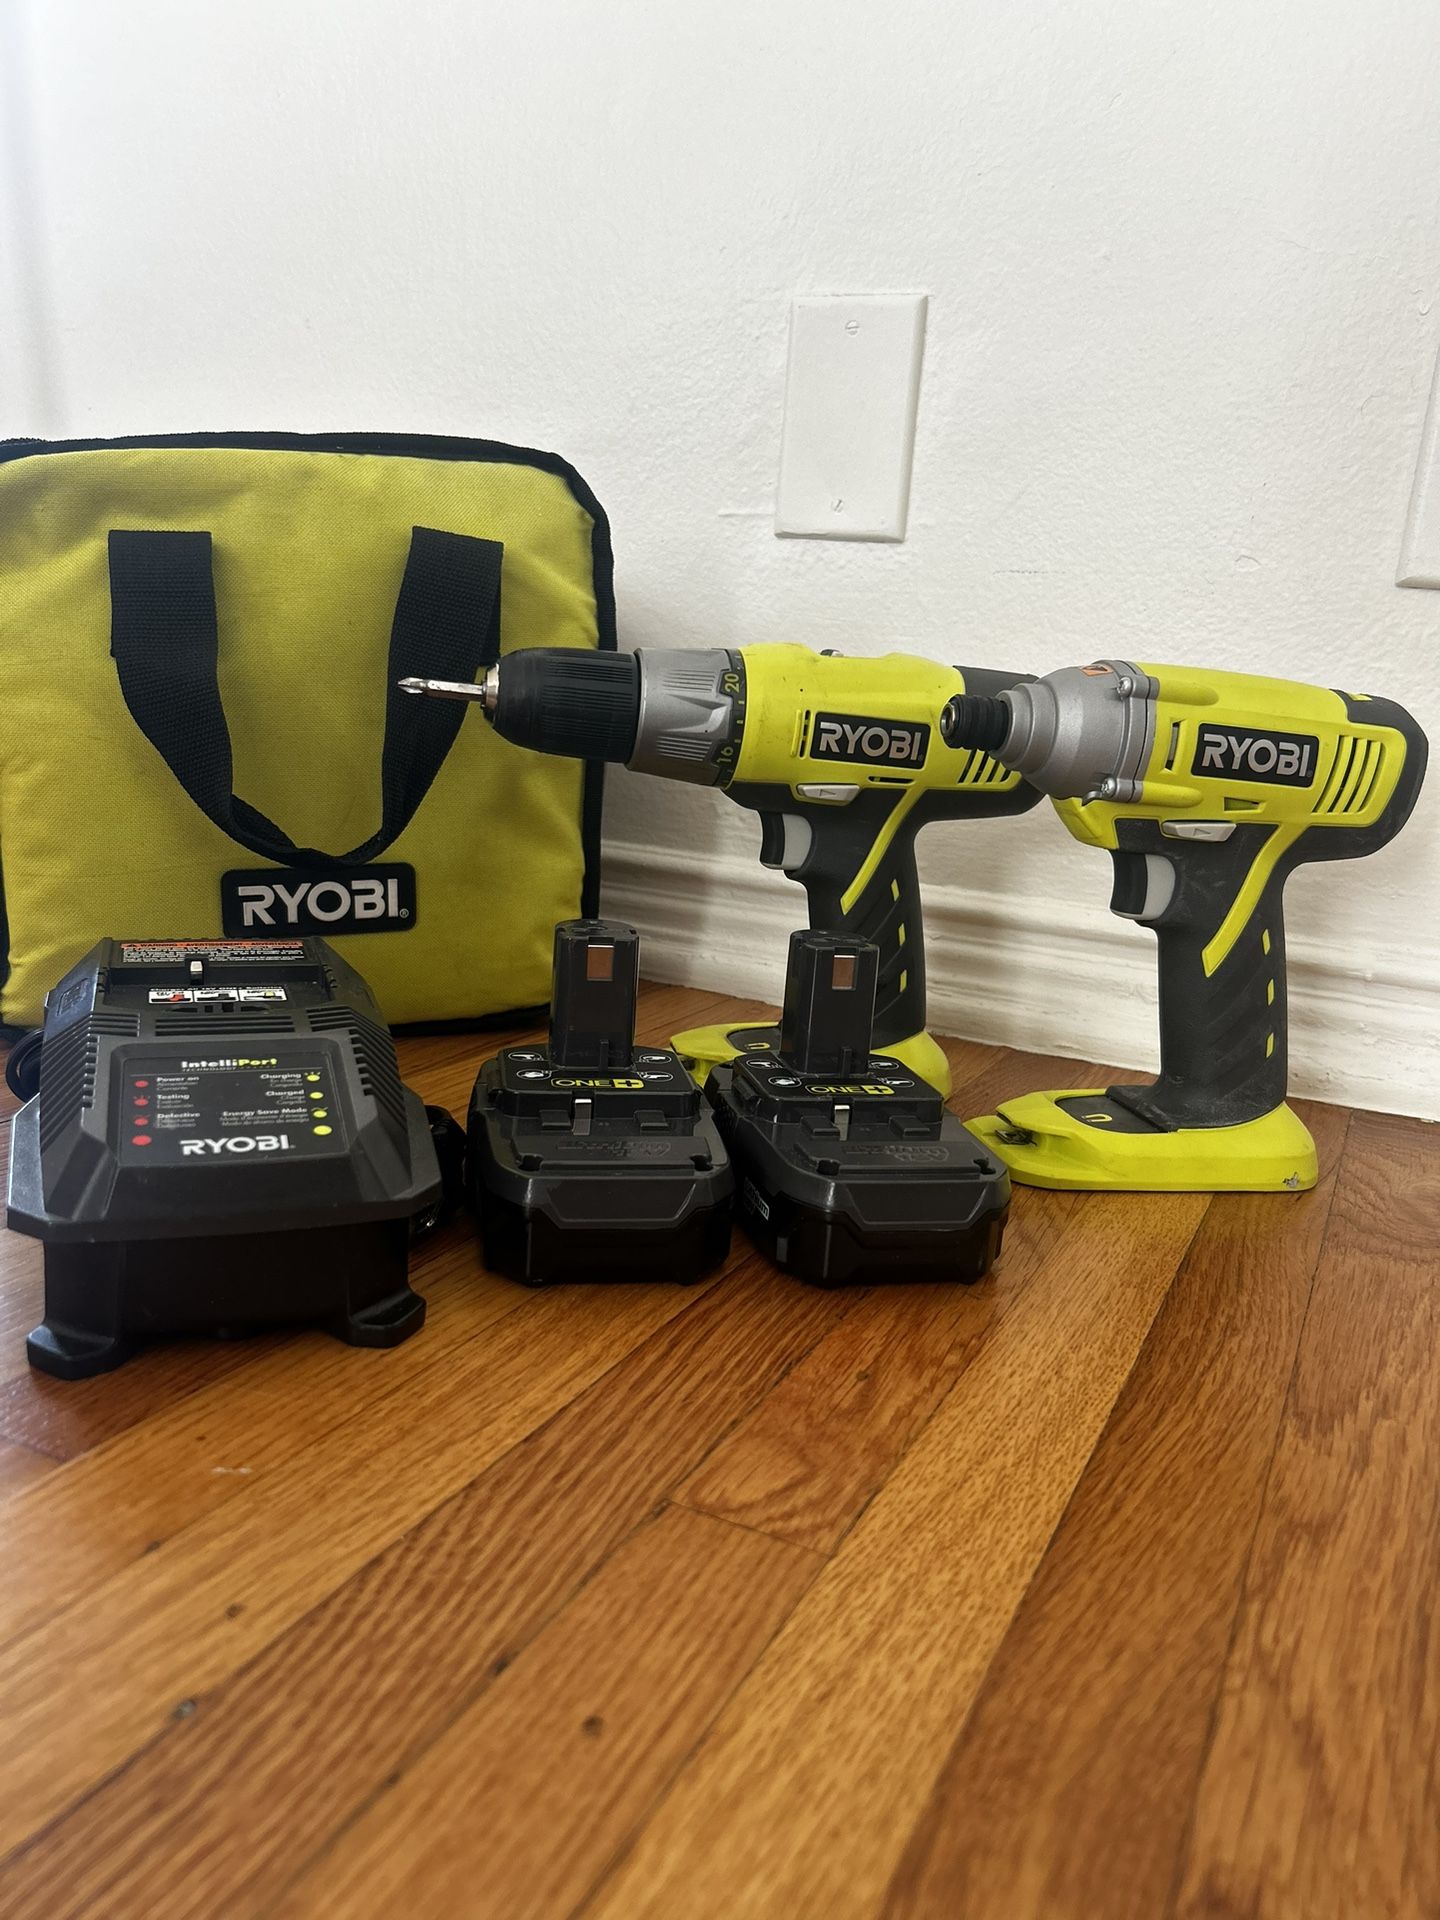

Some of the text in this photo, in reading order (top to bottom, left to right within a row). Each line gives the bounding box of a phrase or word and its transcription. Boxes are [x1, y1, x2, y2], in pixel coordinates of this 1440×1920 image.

[723, 672, 740, 693] 20
[819, 721, 922, 761] RYOBI
[716, 746, 734, 763] 16
[1201, 733, 1311, 777] RYOBI
[238, 878, 399, 927] RYOBI
[181, 1058, 278, 1069] IntelliPort
[265, 1089, 305, 1097] Charged
[223, 1111, 256, 1119] Energy
[180, 1134, 290, 1155] RYOBI
